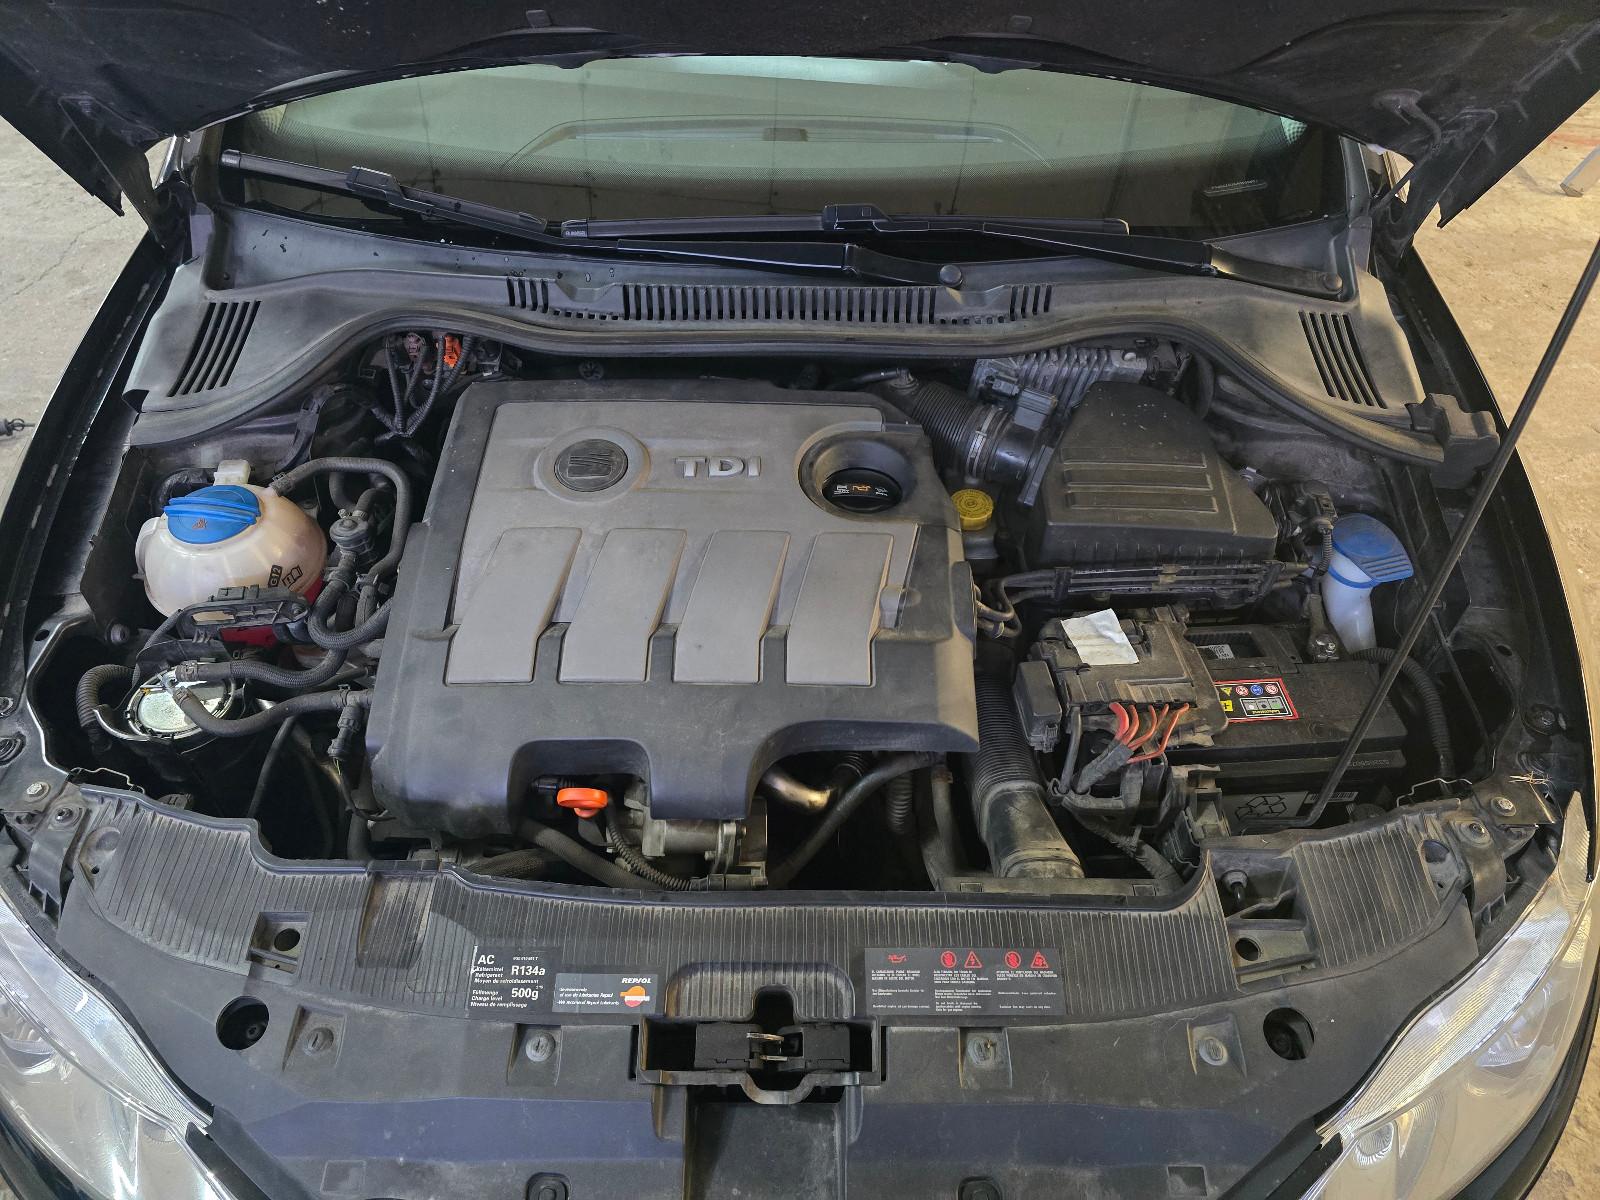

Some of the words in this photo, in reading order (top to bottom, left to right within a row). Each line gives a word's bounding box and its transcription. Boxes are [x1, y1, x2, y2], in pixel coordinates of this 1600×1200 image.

[674, 456, 761, 477] TDI
[270, 567, 281, 586] G12
[477, 954, 495, 965] AC
[511, 965, 546, 976] R134a
[511, 987, 539, 1001] 500g
